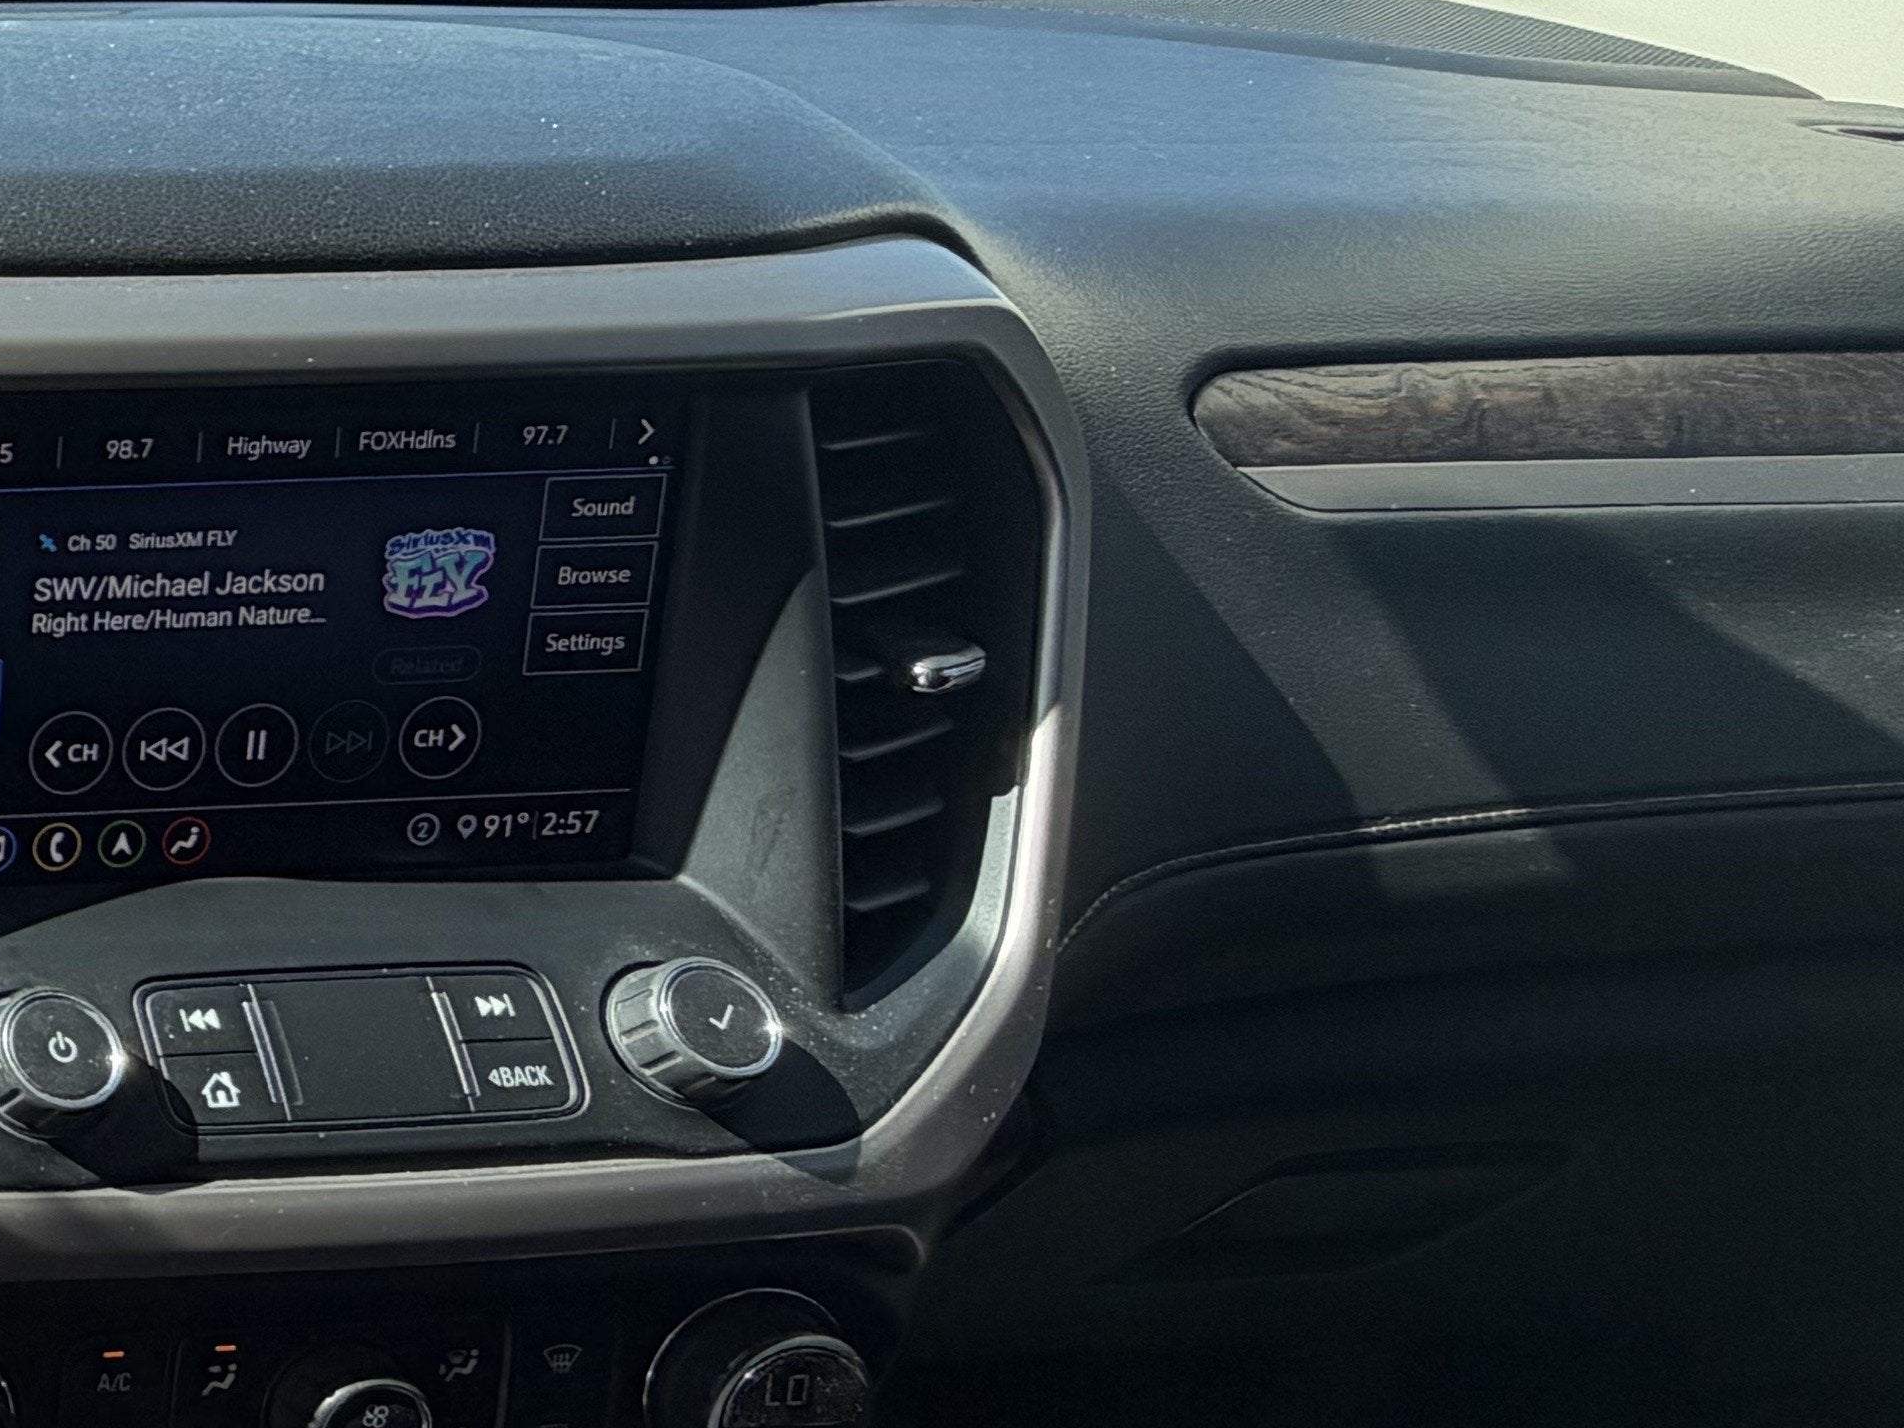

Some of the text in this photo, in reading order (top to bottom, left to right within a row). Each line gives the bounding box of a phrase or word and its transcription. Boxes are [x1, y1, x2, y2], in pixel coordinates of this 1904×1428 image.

[522, 424, 569, 446] 97.7
[105, 438, 155, 460] 98.7
[226, 435, 312, 461] Highway
[570, 496, 636, 520] Sound
[67, 529, 239, 553] Ch 50 SiriusXM FLY
[33, 568, 326, 603] SWV/Michael Jackson
[387, 549, 489, 609] FLY
[556, 565, 632, 587] Browse
[30, 612, 90, 639] Right
[92, 607, 233, 635] Here/Human
[544, 632, 626, 656] Settings
[413, 728, 445, 748] CH
[67, 743, 100, 763] CH
[483, 810, 531, 839] 91°
[540, 808, 601, 837] 2:57
[498, 1064, 554, 1088] BACK
[96, 1371, 133, 1393] A/C
